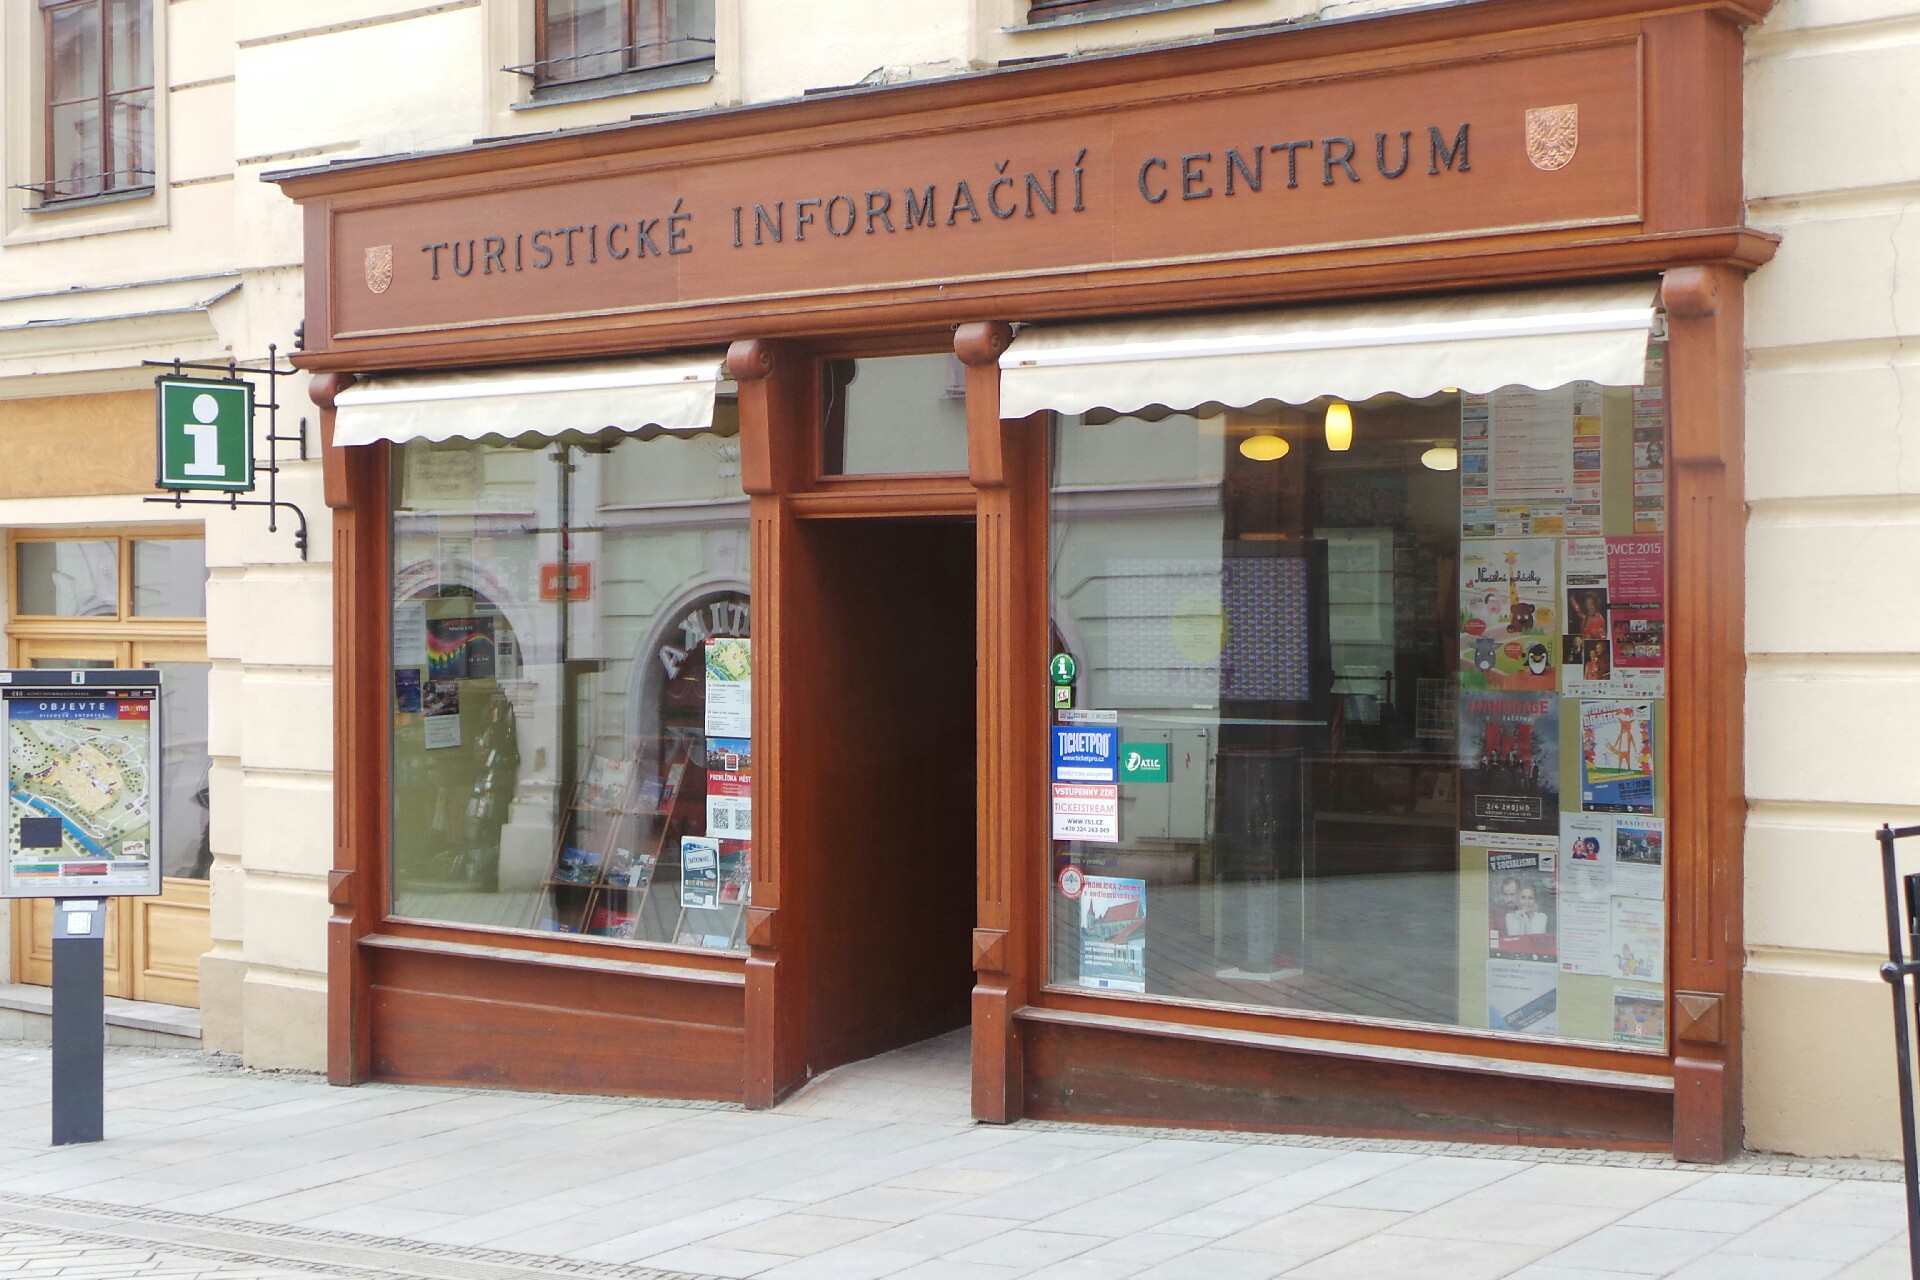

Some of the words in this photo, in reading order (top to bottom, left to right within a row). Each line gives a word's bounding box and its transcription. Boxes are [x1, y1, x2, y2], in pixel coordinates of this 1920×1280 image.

[422, 198, 692, 281] TURISTICKÉ
[733, 147, 1087, 249] INFORMAČNÍ
[1137, 122, 1470, 204] CENTRUM
[39, 702, 106, 711] OBJEVTE
[1058, 732, 1109, 758] TICKETPRO
[1054, 787, 1098, 796] VSTUPENKY
[1099, 789, 1115, 797] ZDE
[1054, 803, 1114, 813] TICKETSTREAM
